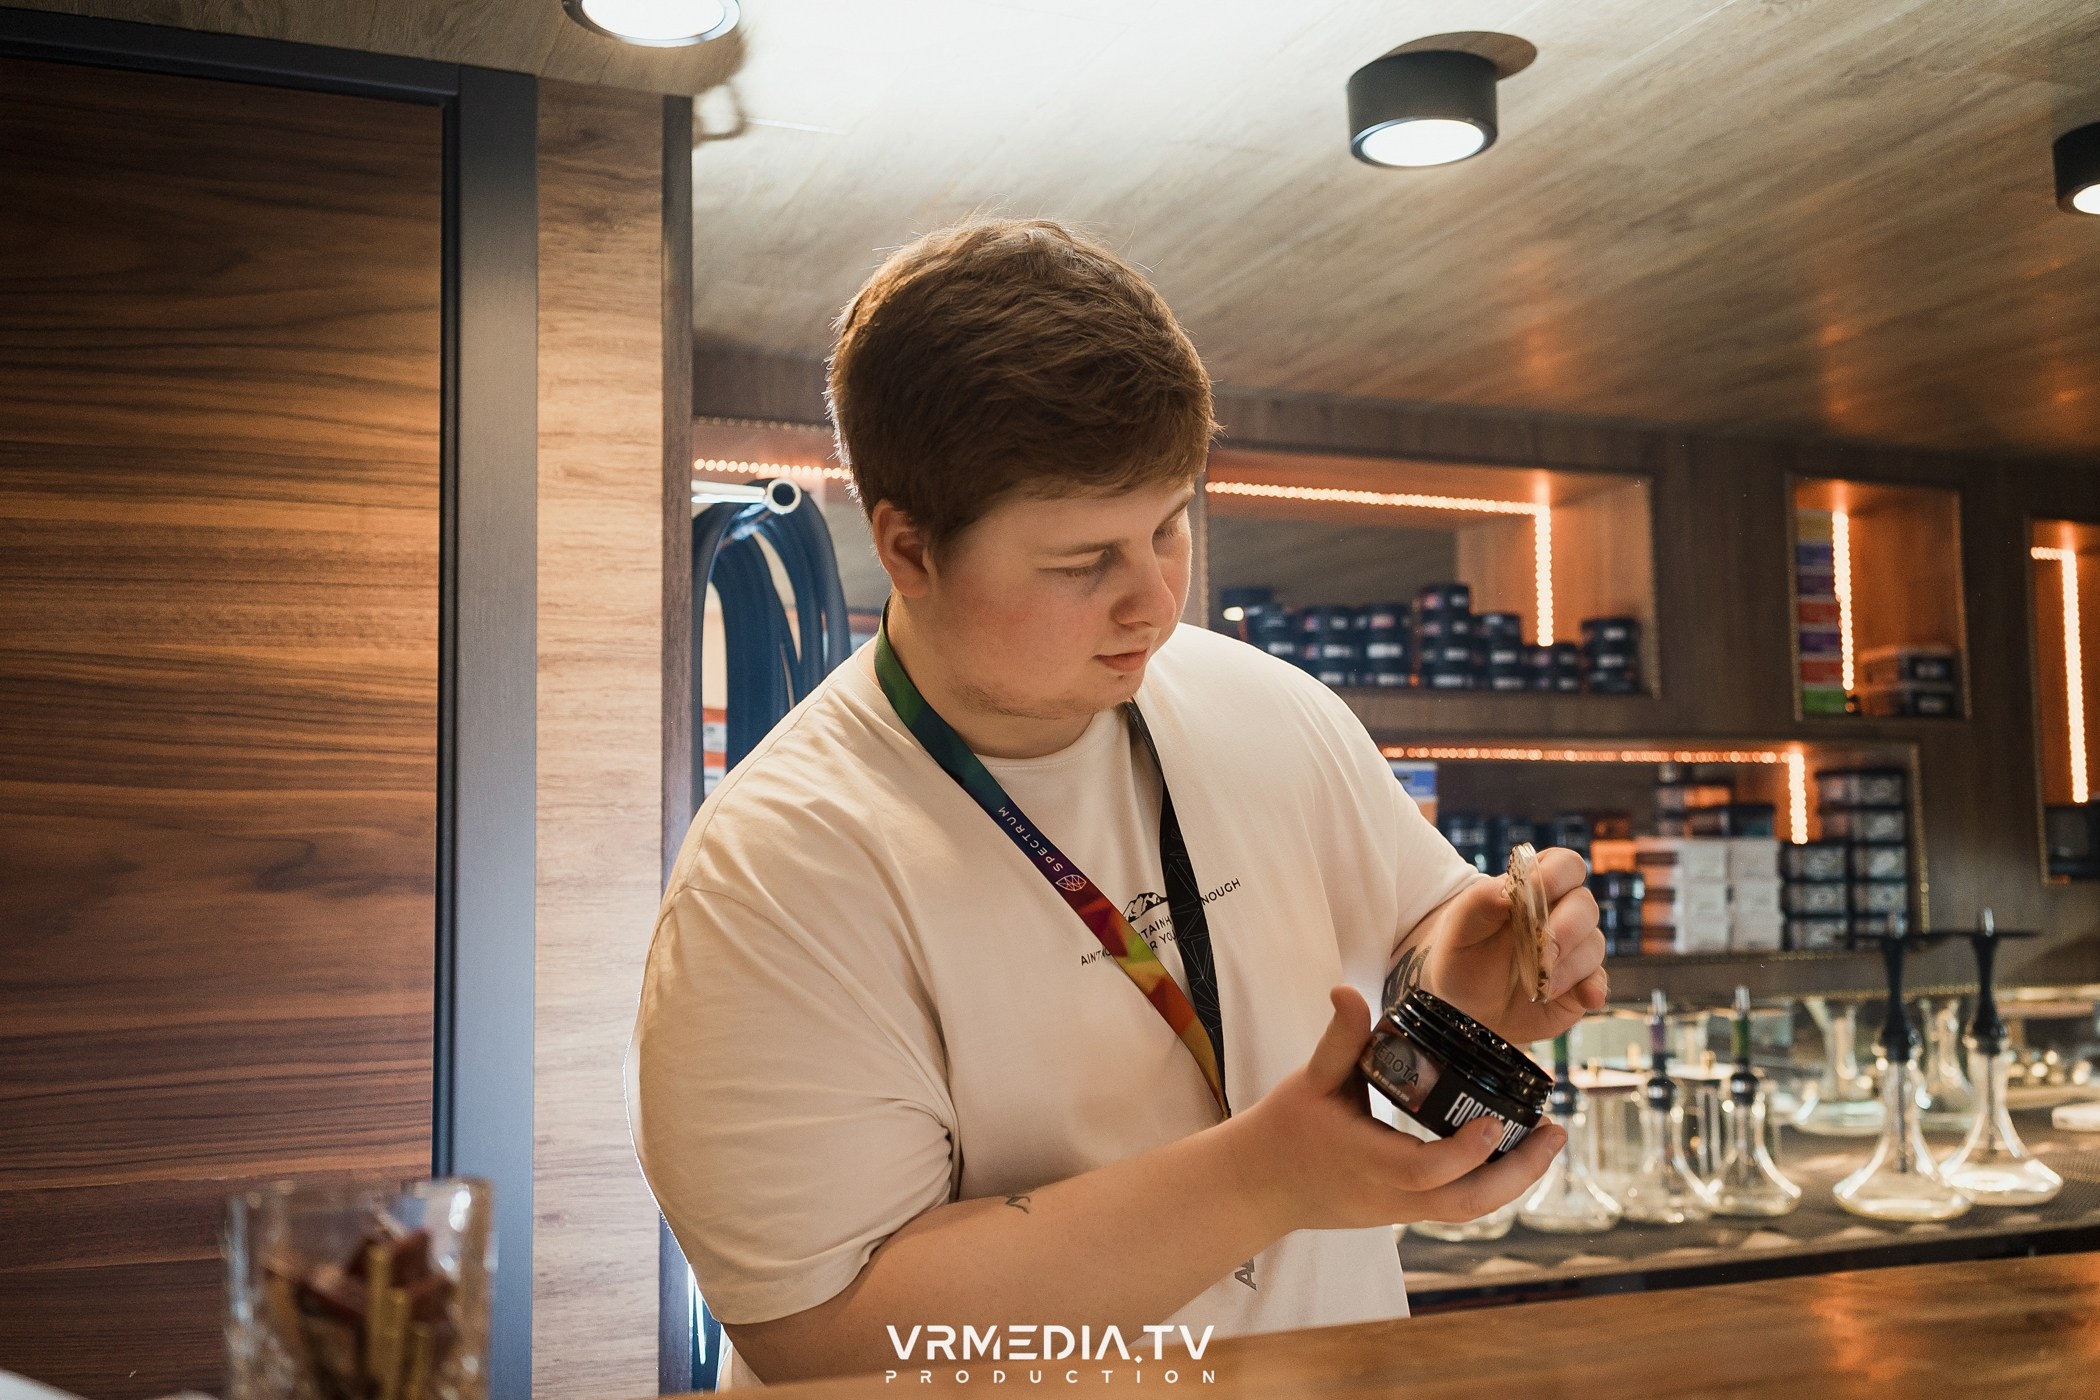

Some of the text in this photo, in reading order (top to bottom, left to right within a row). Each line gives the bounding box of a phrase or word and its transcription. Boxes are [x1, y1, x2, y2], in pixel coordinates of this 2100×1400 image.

[998, 806, 1064, 872] SPECTRUM
[1200, 878, 1241, 906] NOUGH
[1370, 1037, 1419, 1086] ЛЕПОТА
[1444, 1092, 1505, 1127] FOR
